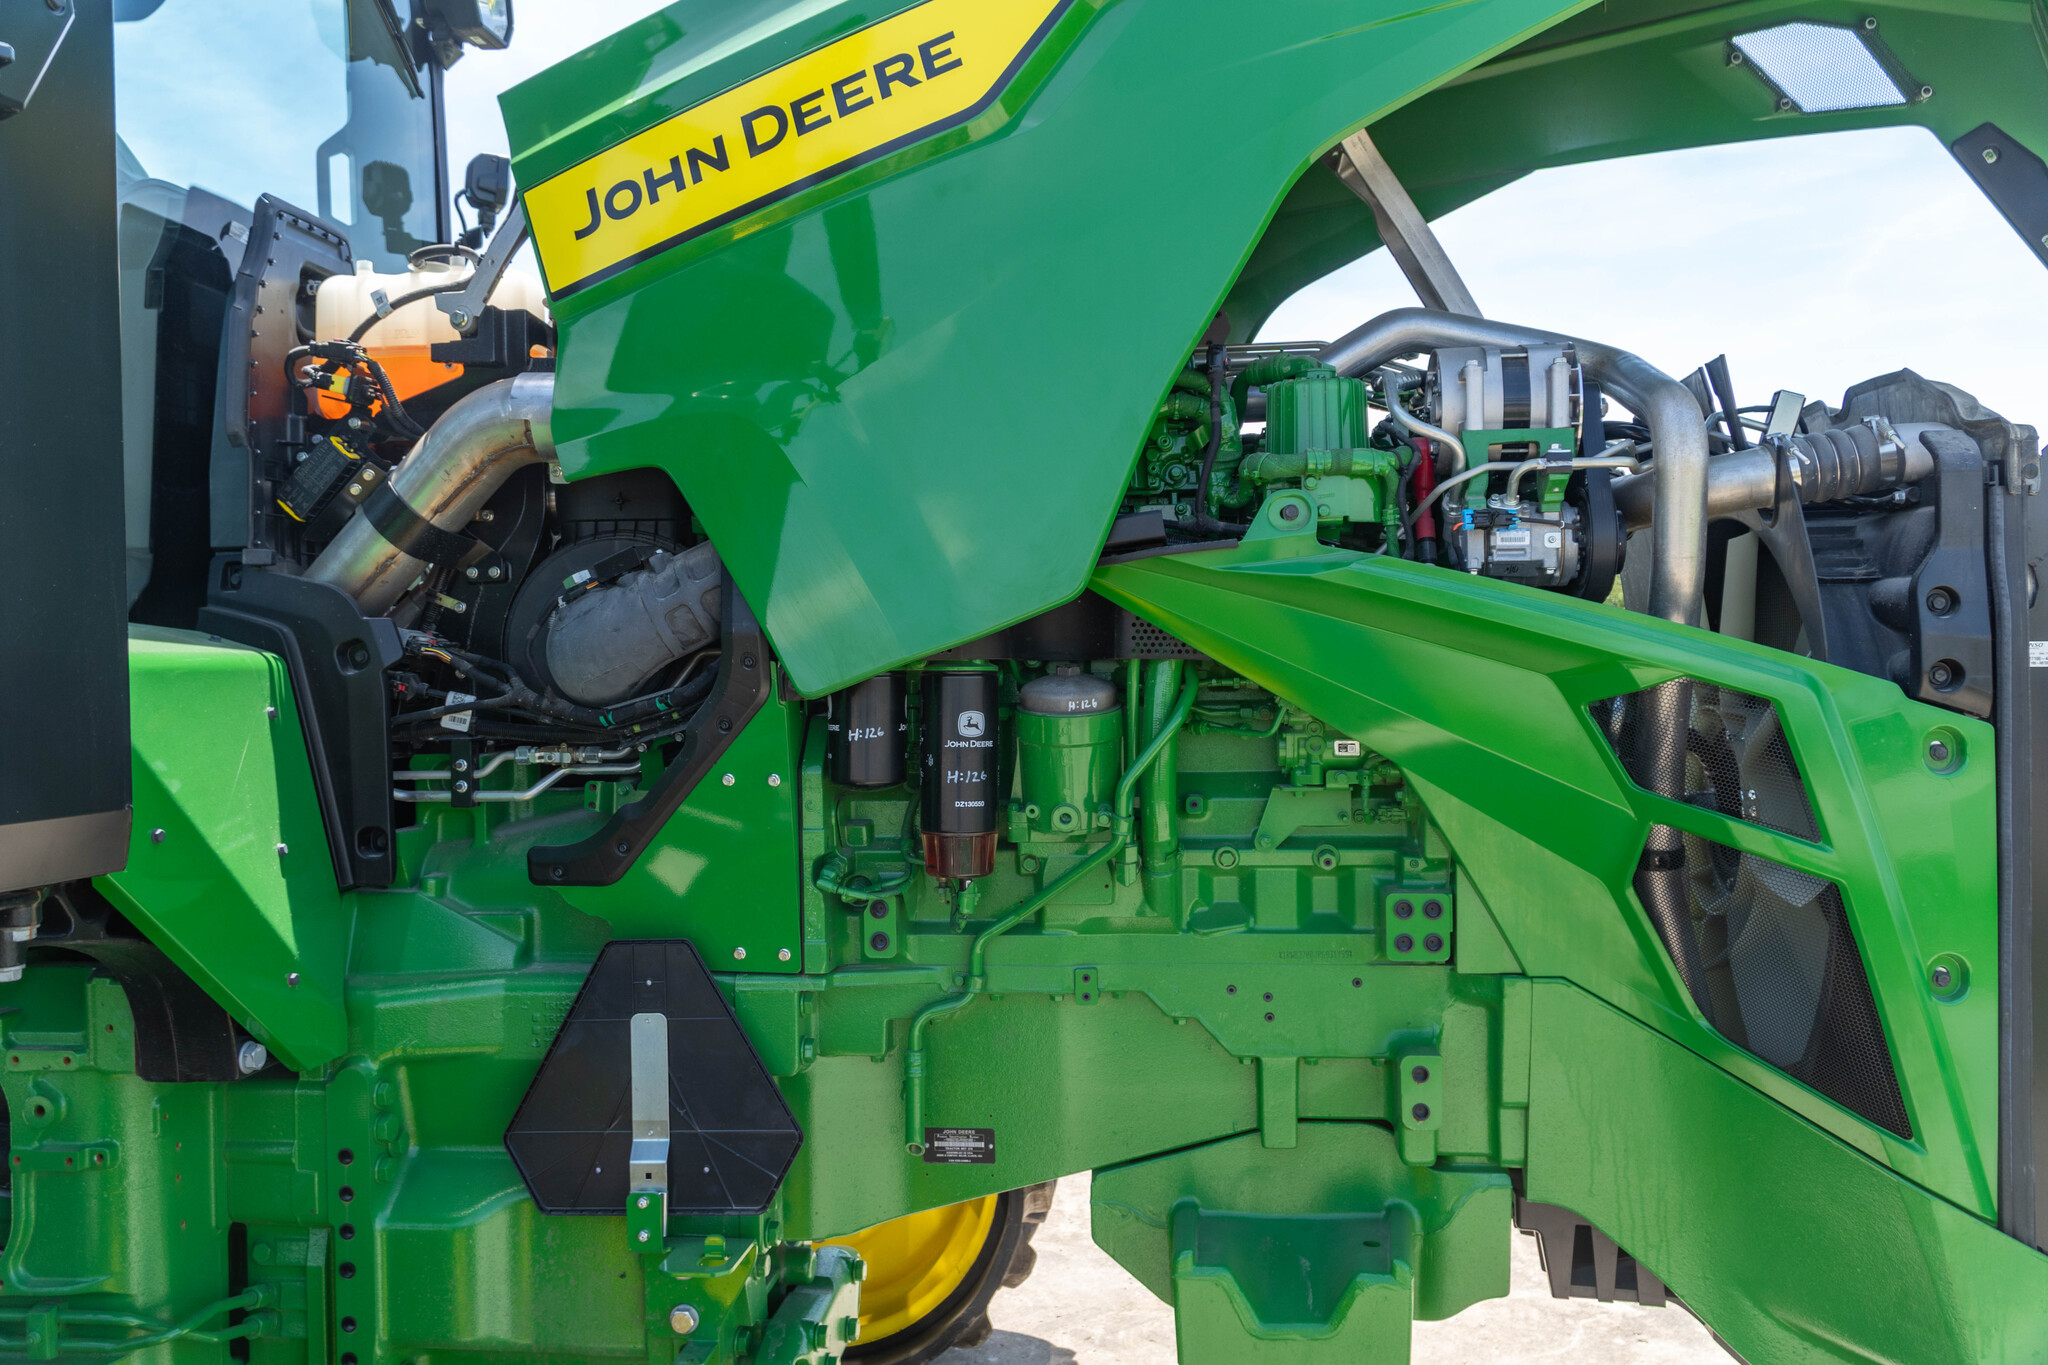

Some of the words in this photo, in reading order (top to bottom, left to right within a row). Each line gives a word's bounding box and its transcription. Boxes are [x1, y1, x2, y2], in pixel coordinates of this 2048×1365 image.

[574, 134, 730, 241] JOHN
[740, 30, 963, 158] DEERE
[944, 740, 969, 748] JOHN
[970, 739, 994, 748] DEERE
